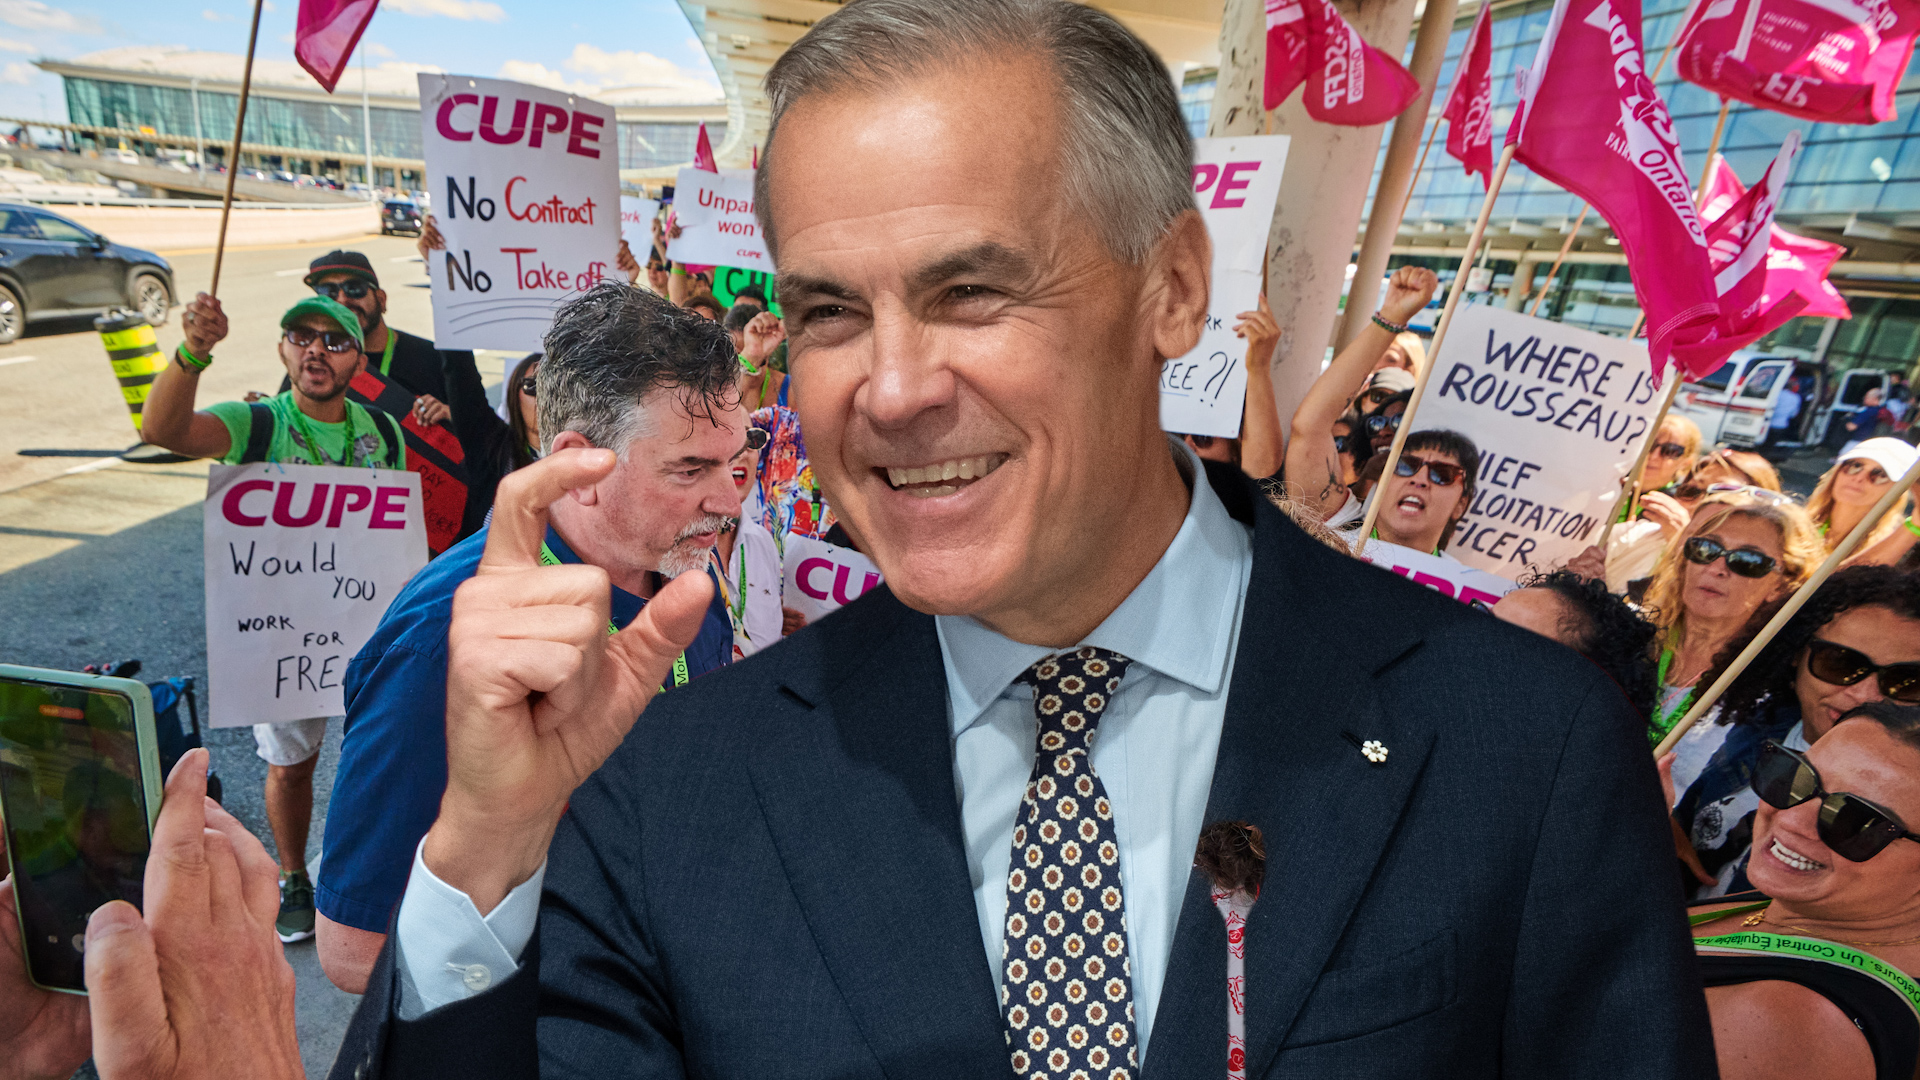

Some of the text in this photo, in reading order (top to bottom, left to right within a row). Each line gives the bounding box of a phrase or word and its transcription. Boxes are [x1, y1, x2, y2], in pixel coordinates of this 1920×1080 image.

[435, 93, 605, 159] CUPE
[446, 176, 597, 226] No Contract
[1639, 149, 1702, 236] Ontario
[446, 249, 492, 293] No
[500, 248, 572, 290] Take
[737, 249, 763, 259] CUPE
[1485, 329, 1656, 405] WHERE IS
[1439, 362, 1648, 454] ROUSSEAU?
[221, 479, 410, 530] CUPE
[1470, 486, 1599, 541] LOITATION
[229, 540, 336, 577] Would
[332, 575, 376, 601] YOU
[238, 615, 295, 632] WORK
[303, 631, 344, 647] FOR
[275, 655, 346, 699] FRE
[1714, 933, 1771, 949] Équitable
[1776, 937, 1835, 957] Contrat
[1840, 952, 1865, 967] Un
